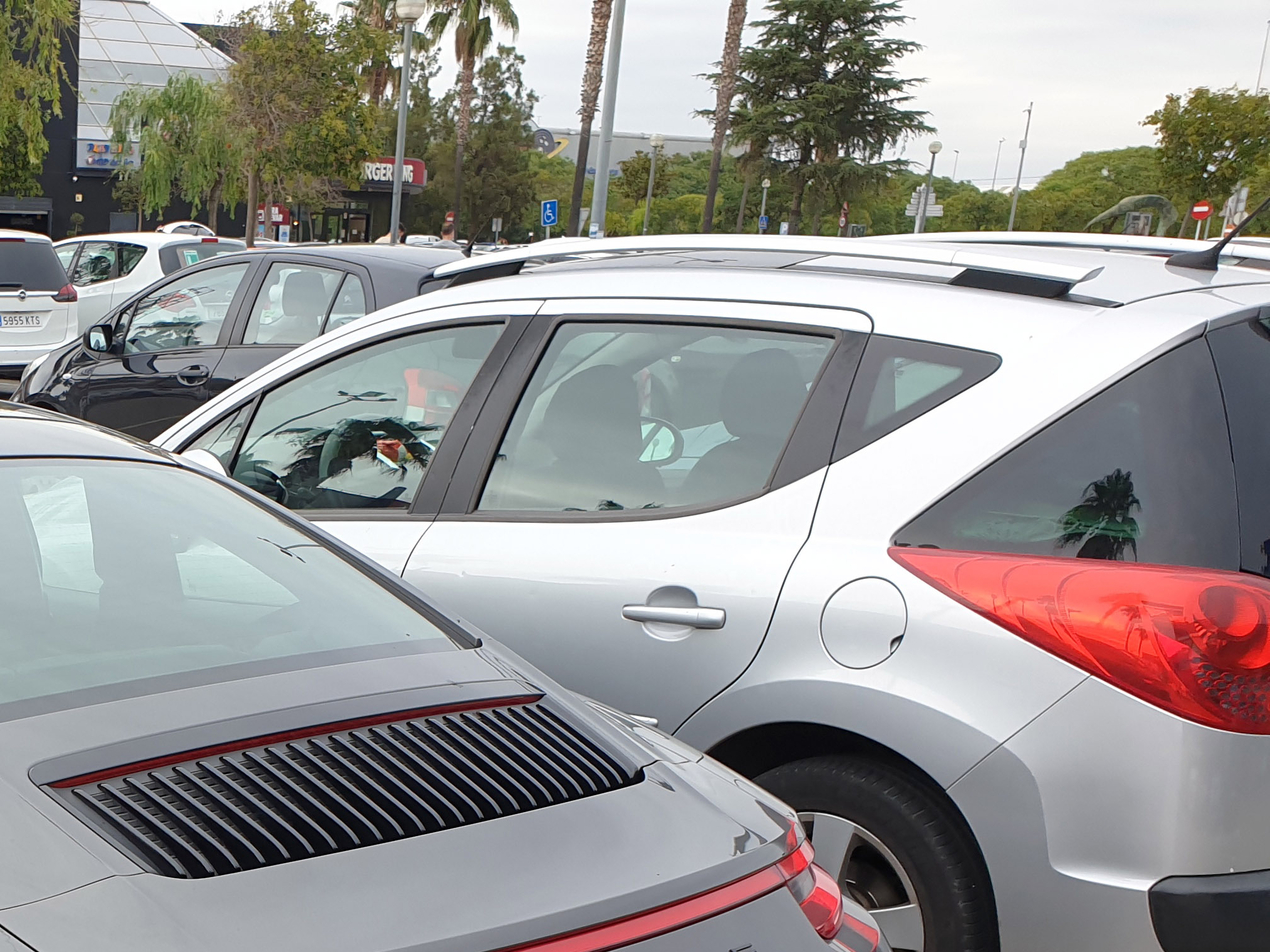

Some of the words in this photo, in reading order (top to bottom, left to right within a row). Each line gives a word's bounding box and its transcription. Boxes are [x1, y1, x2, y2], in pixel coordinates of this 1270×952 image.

[365, 162, 393, 181] RGER
[402, 164, 413, 183] NG
[3, 315, 24, 326] 5955
[25, 315, 41, 325] KTS
